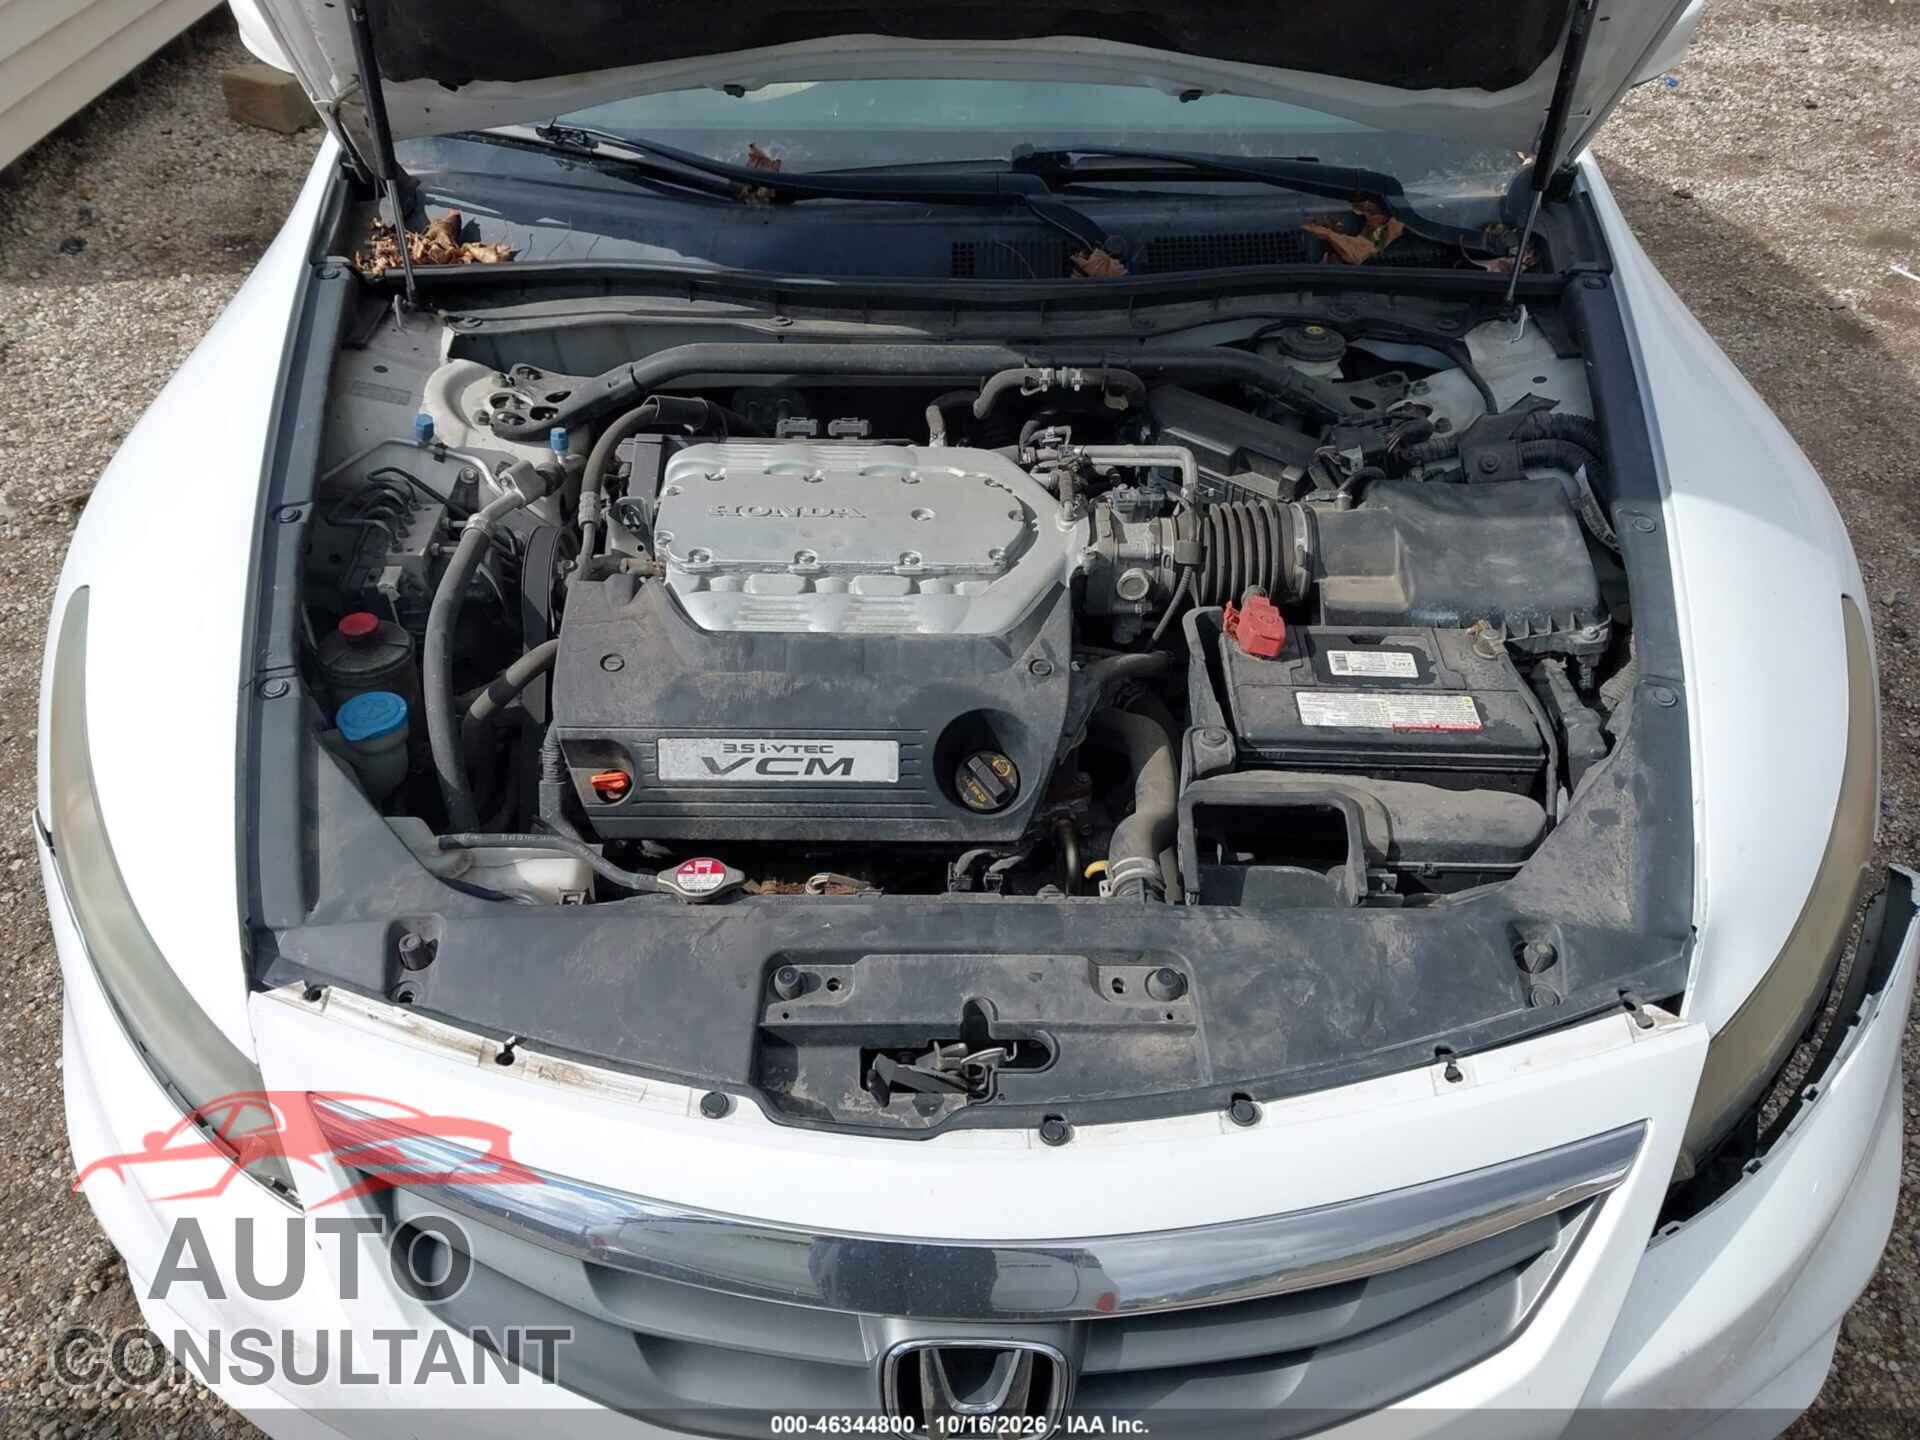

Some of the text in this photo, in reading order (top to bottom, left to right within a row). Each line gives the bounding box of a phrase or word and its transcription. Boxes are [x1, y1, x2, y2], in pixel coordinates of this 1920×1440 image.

[705, 503, 868, 519] HONDA
[723, 742, 835, 754] 3.5 i-VTEC
[701, 757, 855, 776] VCM
